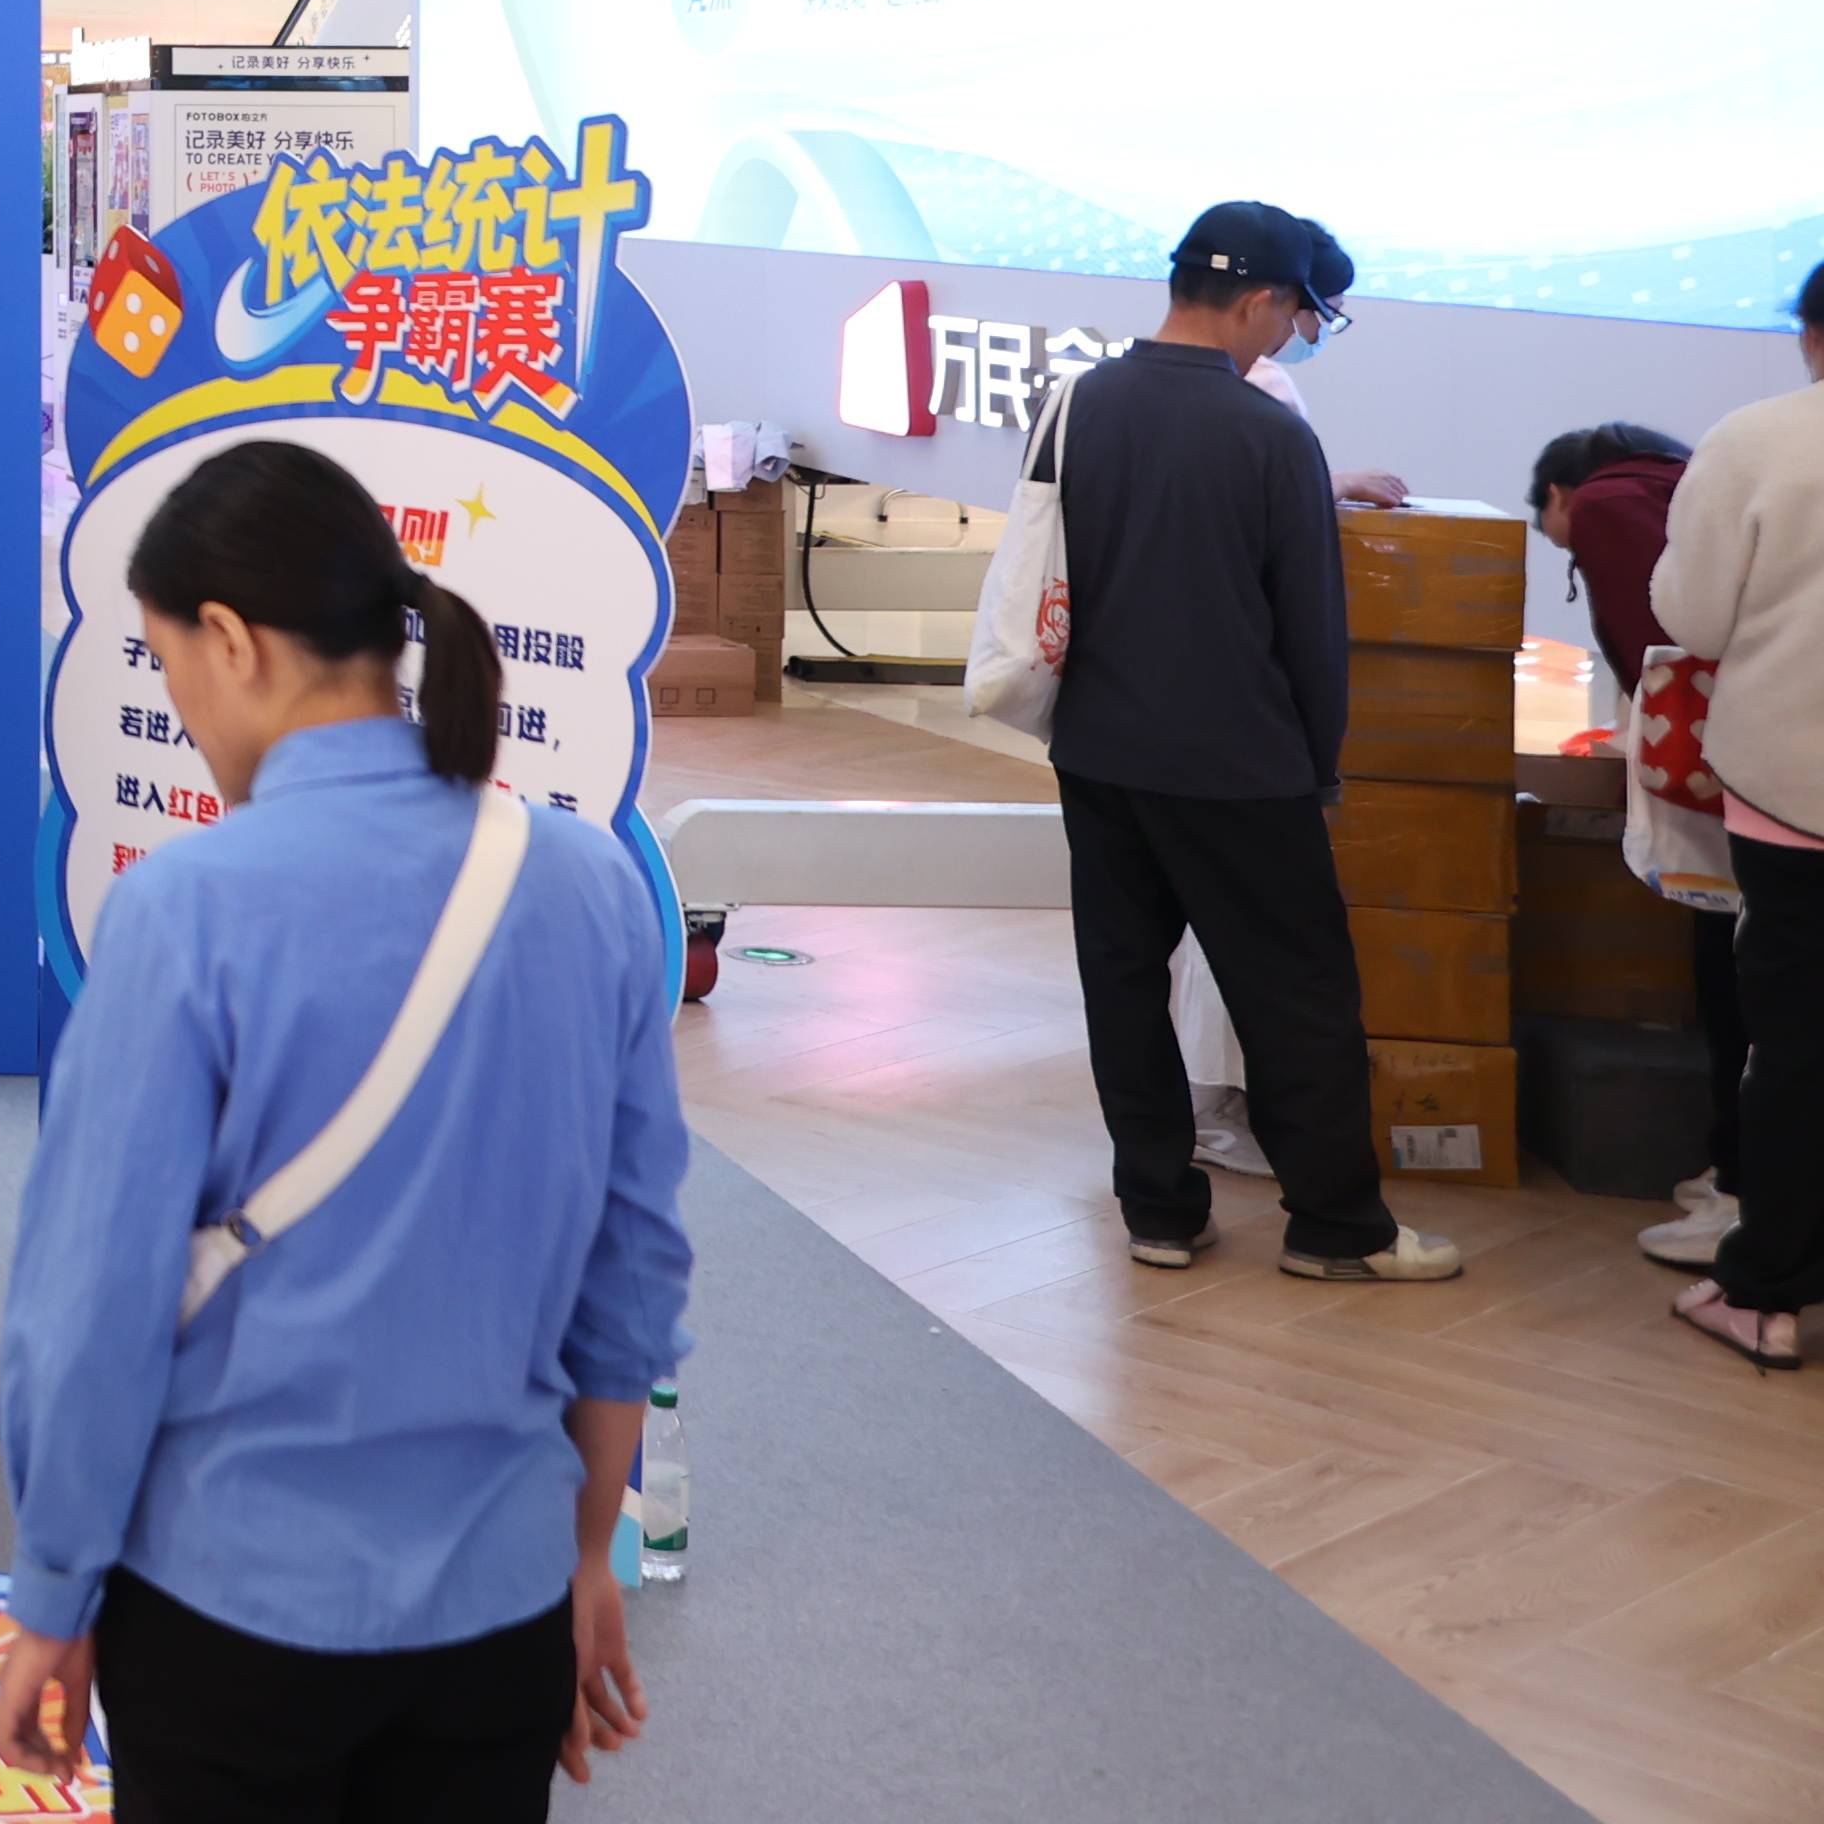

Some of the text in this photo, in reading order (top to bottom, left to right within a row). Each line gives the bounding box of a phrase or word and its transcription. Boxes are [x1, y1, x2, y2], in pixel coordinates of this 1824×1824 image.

[232, 56, 355, 70] 记录美好 分享快乐
[186, 112, 240, 122] FOTOBOX
[185, 130, 355, 151] 记录美好 分享快乐
[186, 153, 203, 165] TO
[207, 153, 260, 165] CREATE
[254, 122, 639, 376] 依法统计
[328, 266, 581, 414] 争霸赛
[115, 773, 232, 827] 进入红色
